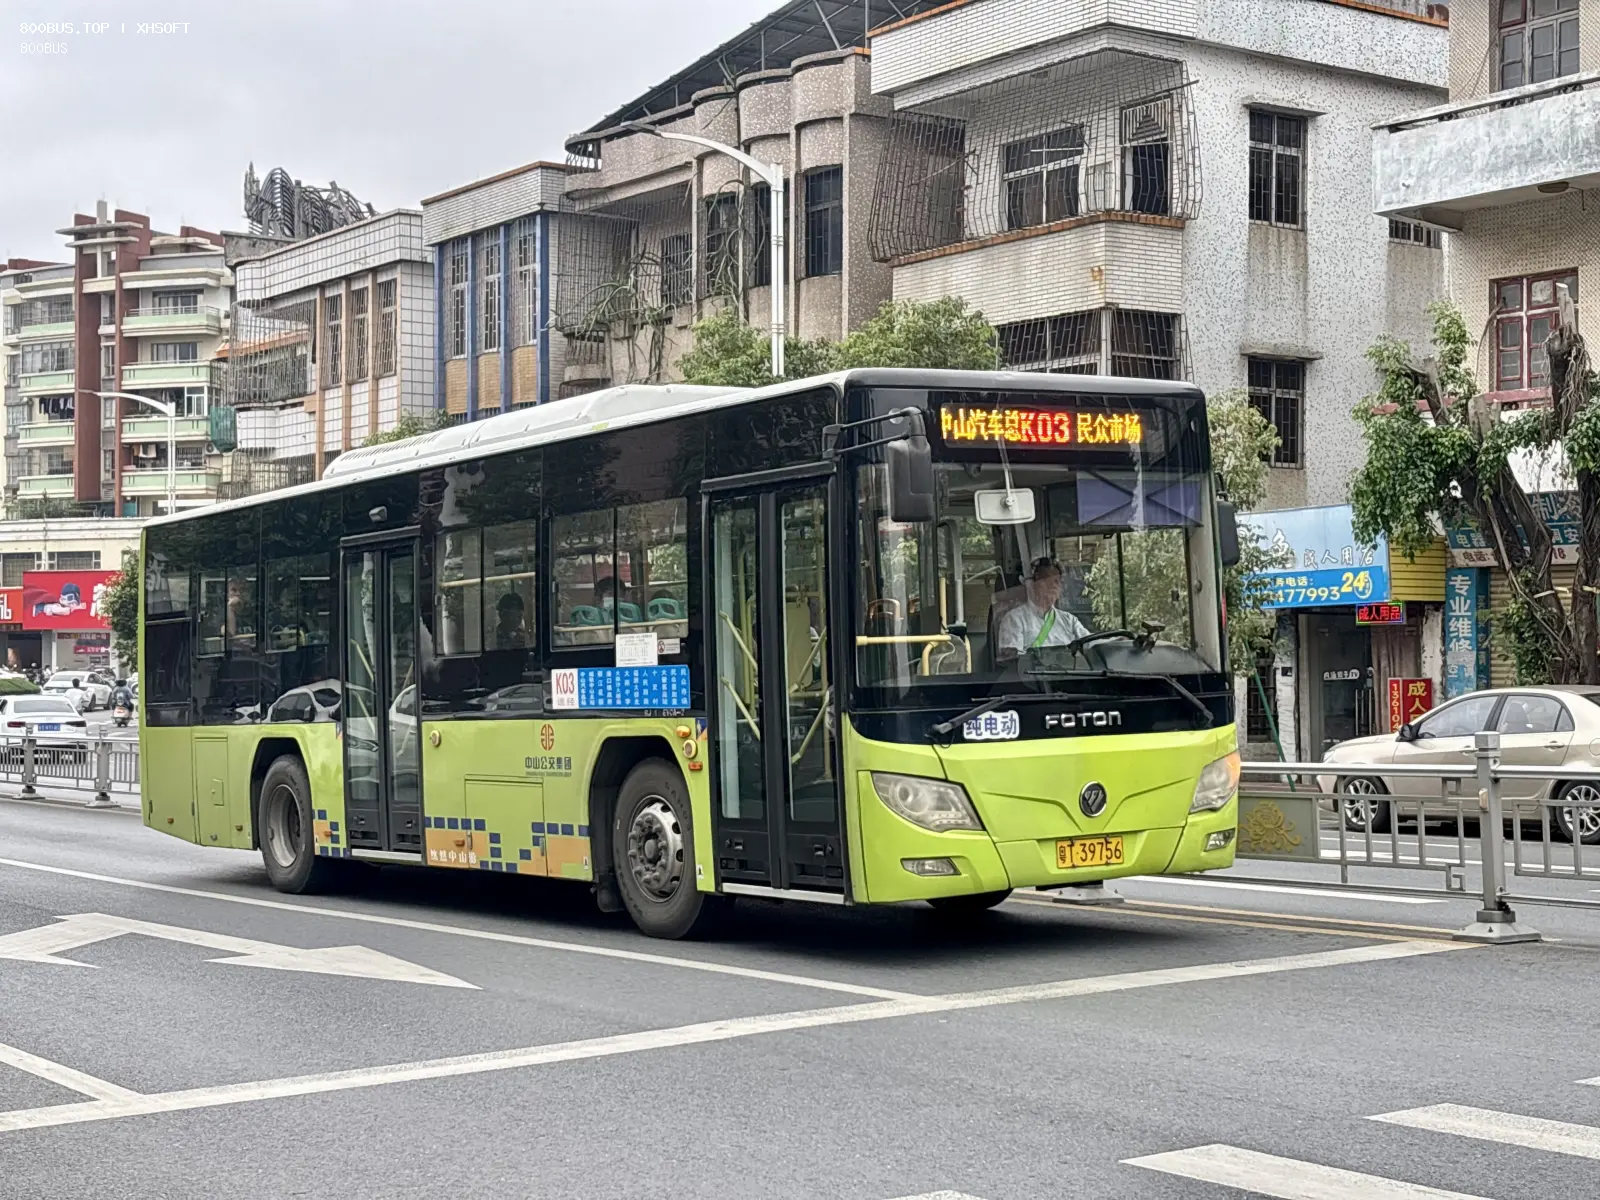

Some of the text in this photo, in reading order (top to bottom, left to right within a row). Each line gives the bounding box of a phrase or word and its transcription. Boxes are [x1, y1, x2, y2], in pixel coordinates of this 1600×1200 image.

[1076, 412, 1141, 443] 民众市场
[1341, 570, 1366, 593] 24
[1358, 605, 1402, 621] 成人用品
[1448, 574, 1473, 652] 专业维修
[555, 672, 575, 695] K03
[965, 714, 1018, 737] 纯电动
[1045, 710, 1122, 730] FOTON
[525, 756, 572, 770] 中山公交集团
